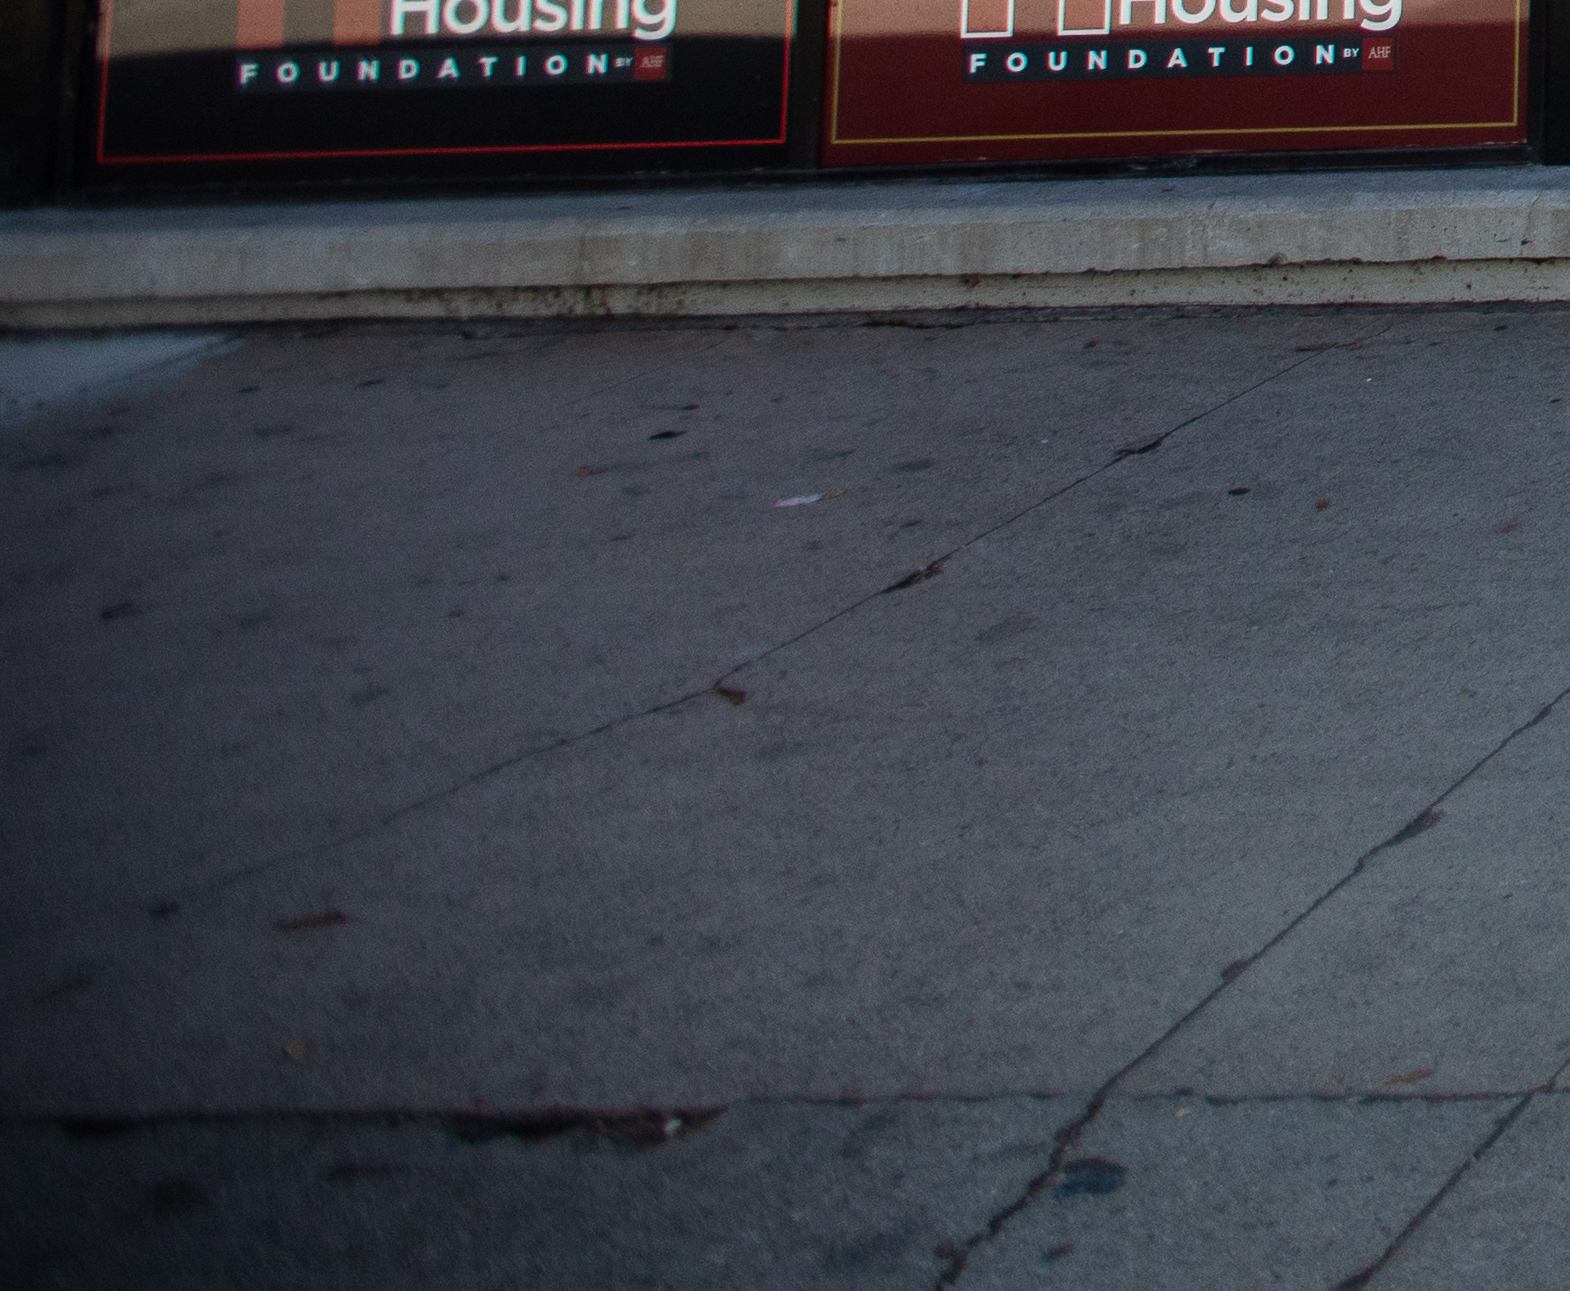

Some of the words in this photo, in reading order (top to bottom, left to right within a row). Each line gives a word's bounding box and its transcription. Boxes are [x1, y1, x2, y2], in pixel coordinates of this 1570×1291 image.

[239, 53, 606, 85] FOUNDATION
[969, 44, 1333, 74] FOUNDATION
[1343, 48, 1359, 58] BY
[1367, 45, 1391, 59] AHF
